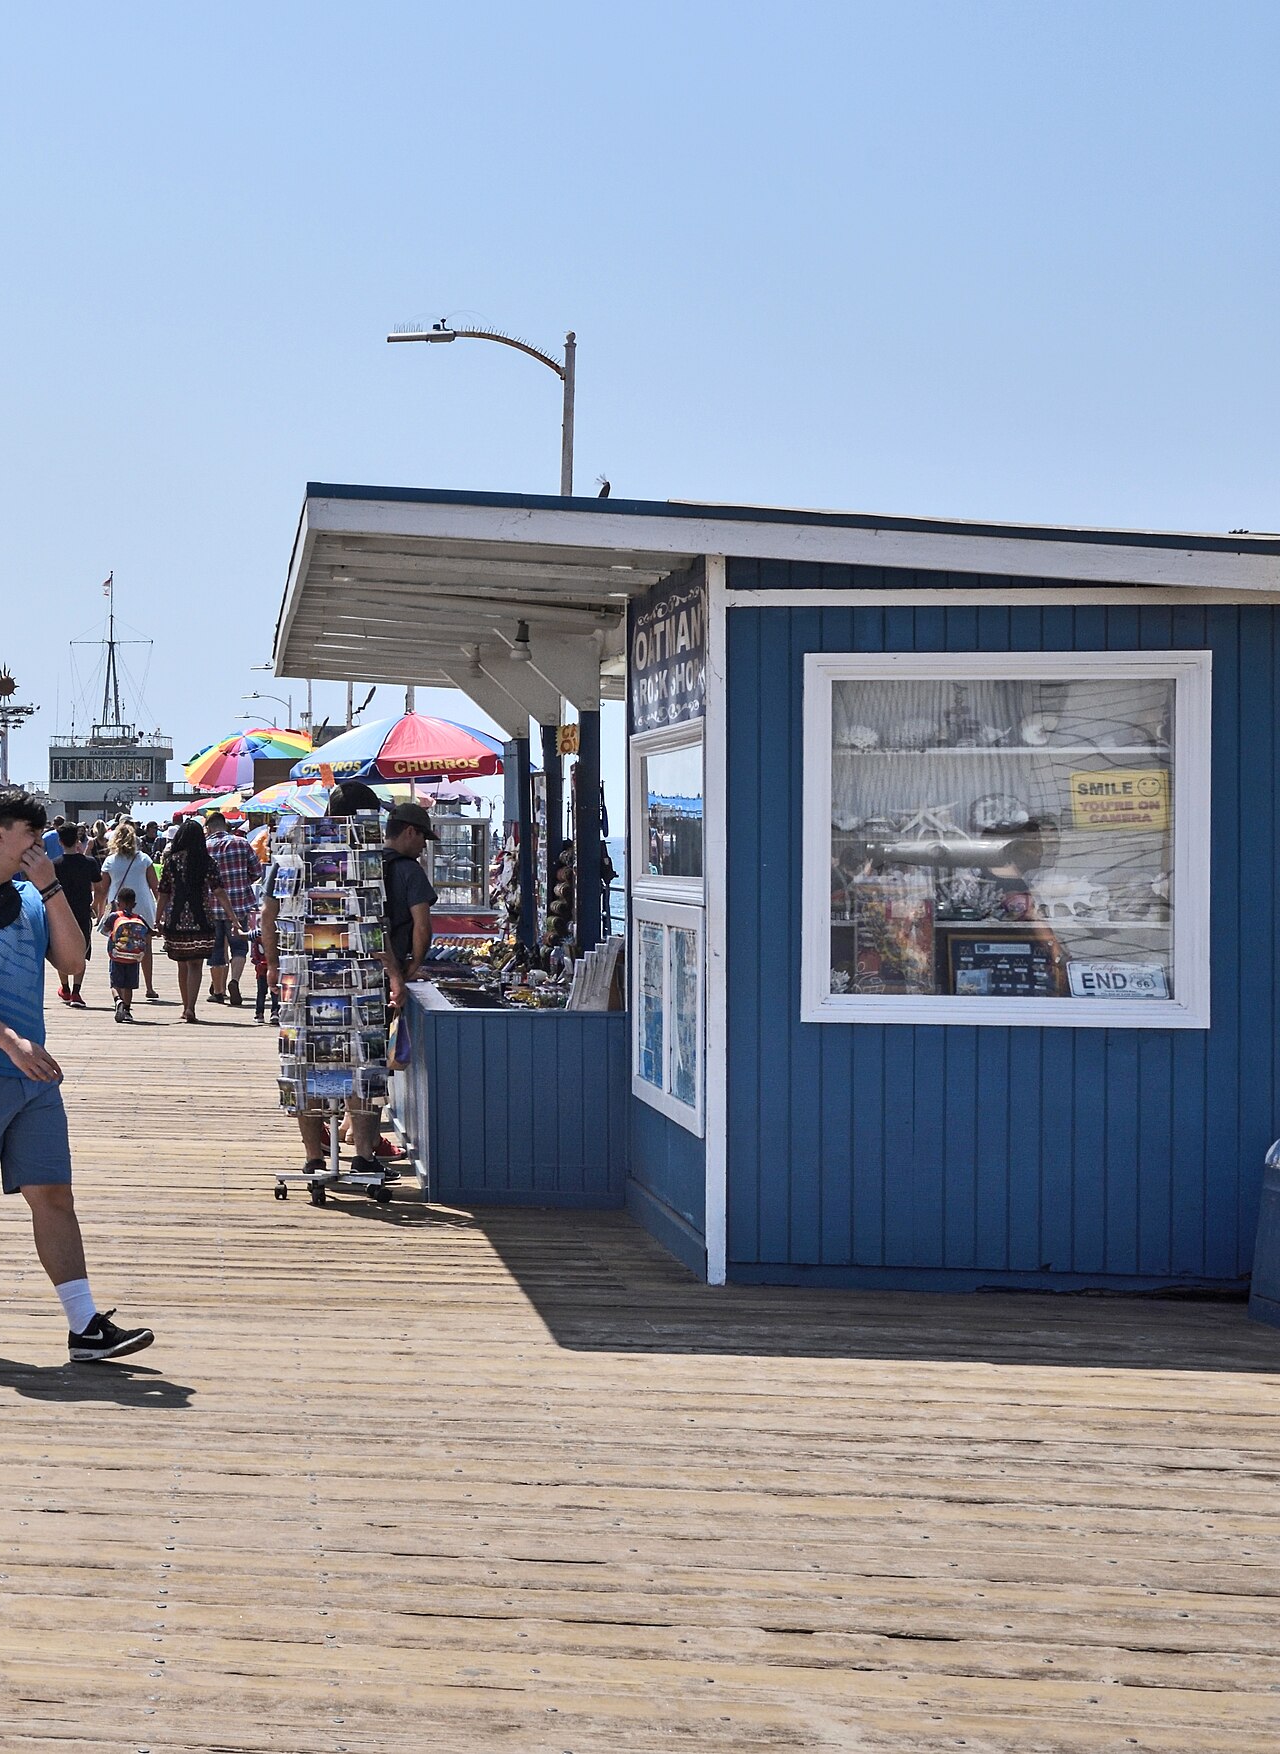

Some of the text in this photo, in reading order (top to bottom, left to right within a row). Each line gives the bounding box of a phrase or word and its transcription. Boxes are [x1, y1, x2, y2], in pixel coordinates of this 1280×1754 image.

[635, 602, 702, 671] OATMAN
[640, 657, 700, 707] ROCK SHOP
[301, 759, 362, 774] CHRROS
[394, 757, 481, 774] CHURROS
[1077, 781, 1134, 796] SMILE
[1080, 800, 1161, 812] YOU'RE ON
[1089, 813, 1153, 823] CAMERA
[1081, 972, 1128, 989] END
[1136, 980, 1150, 988] 66
